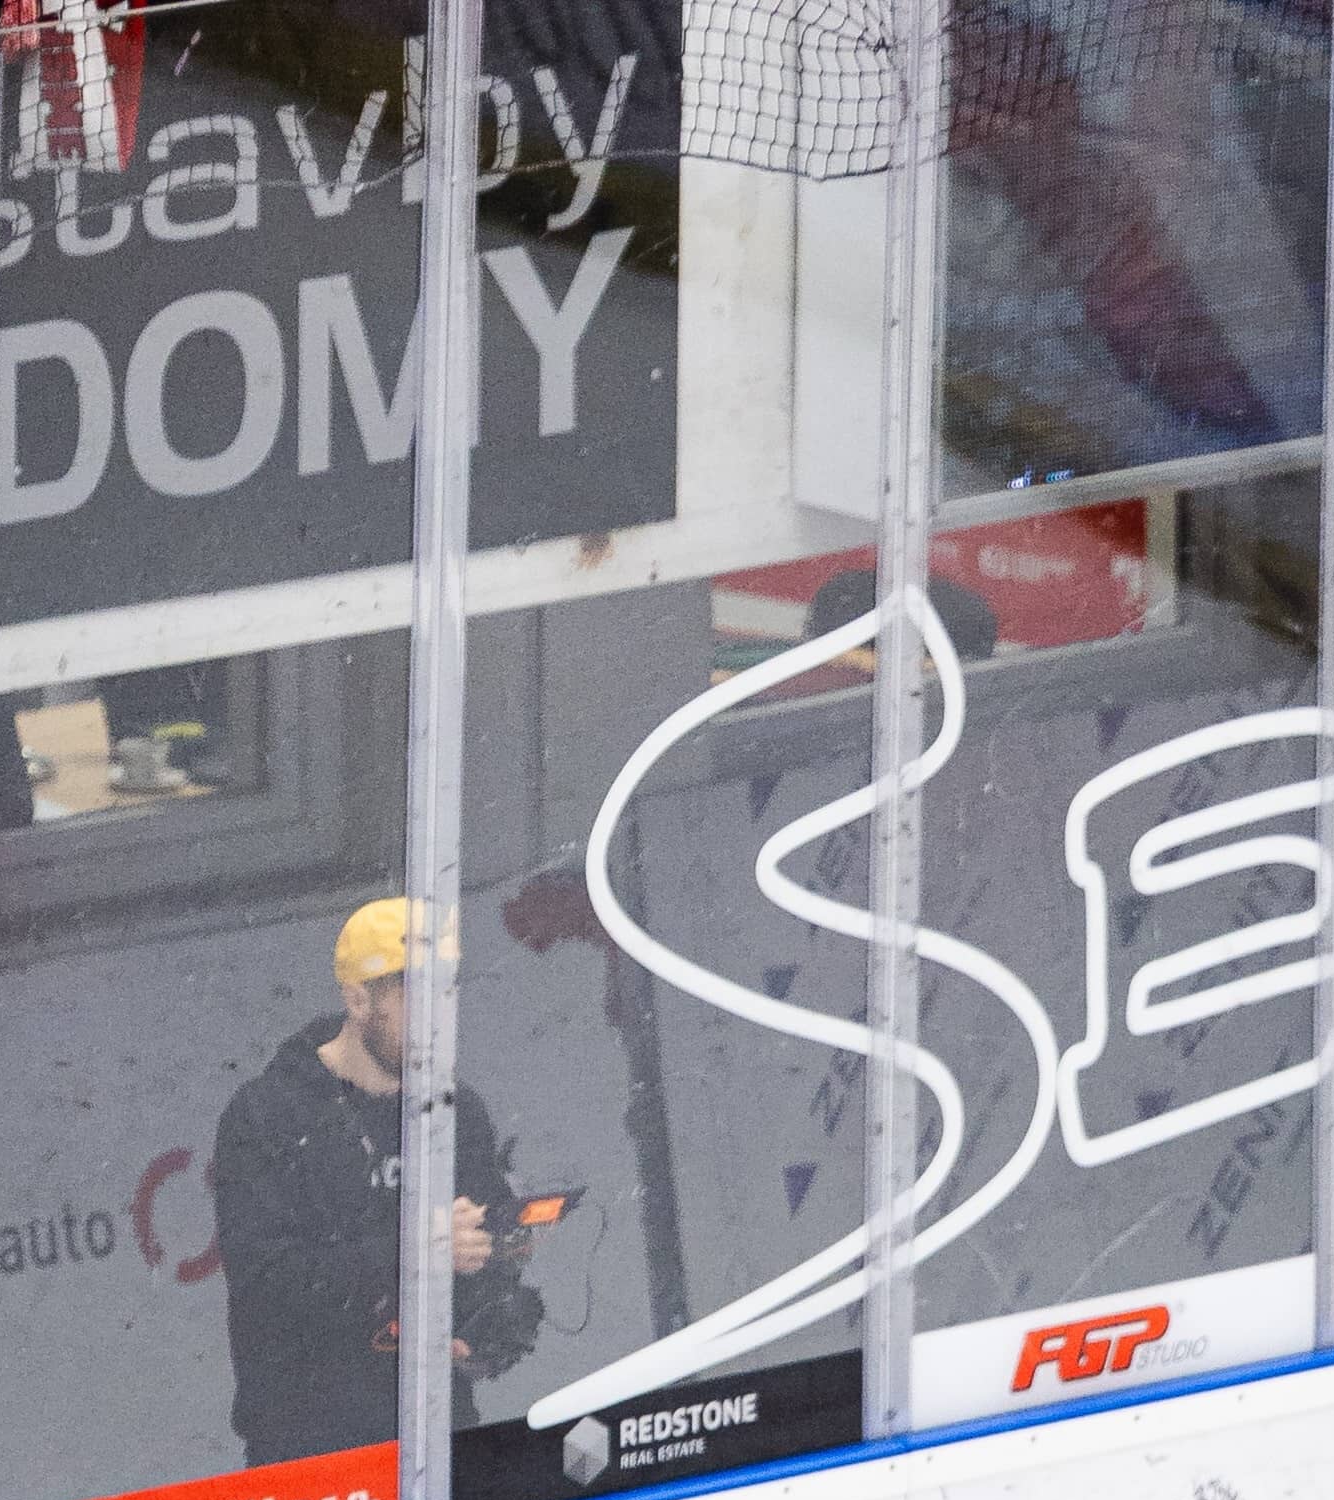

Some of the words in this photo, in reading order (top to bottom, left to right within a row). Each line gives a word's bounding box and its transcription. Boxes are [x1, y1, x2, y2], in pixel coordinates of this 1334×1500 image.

[1135, 1335, 1209, 1371] STUDIO
[619, 1392, 758, 1449] REDSTONE
[619, 1451, 655, 1470] REAL
[657, 1437, 708, 1463] ESTATE
